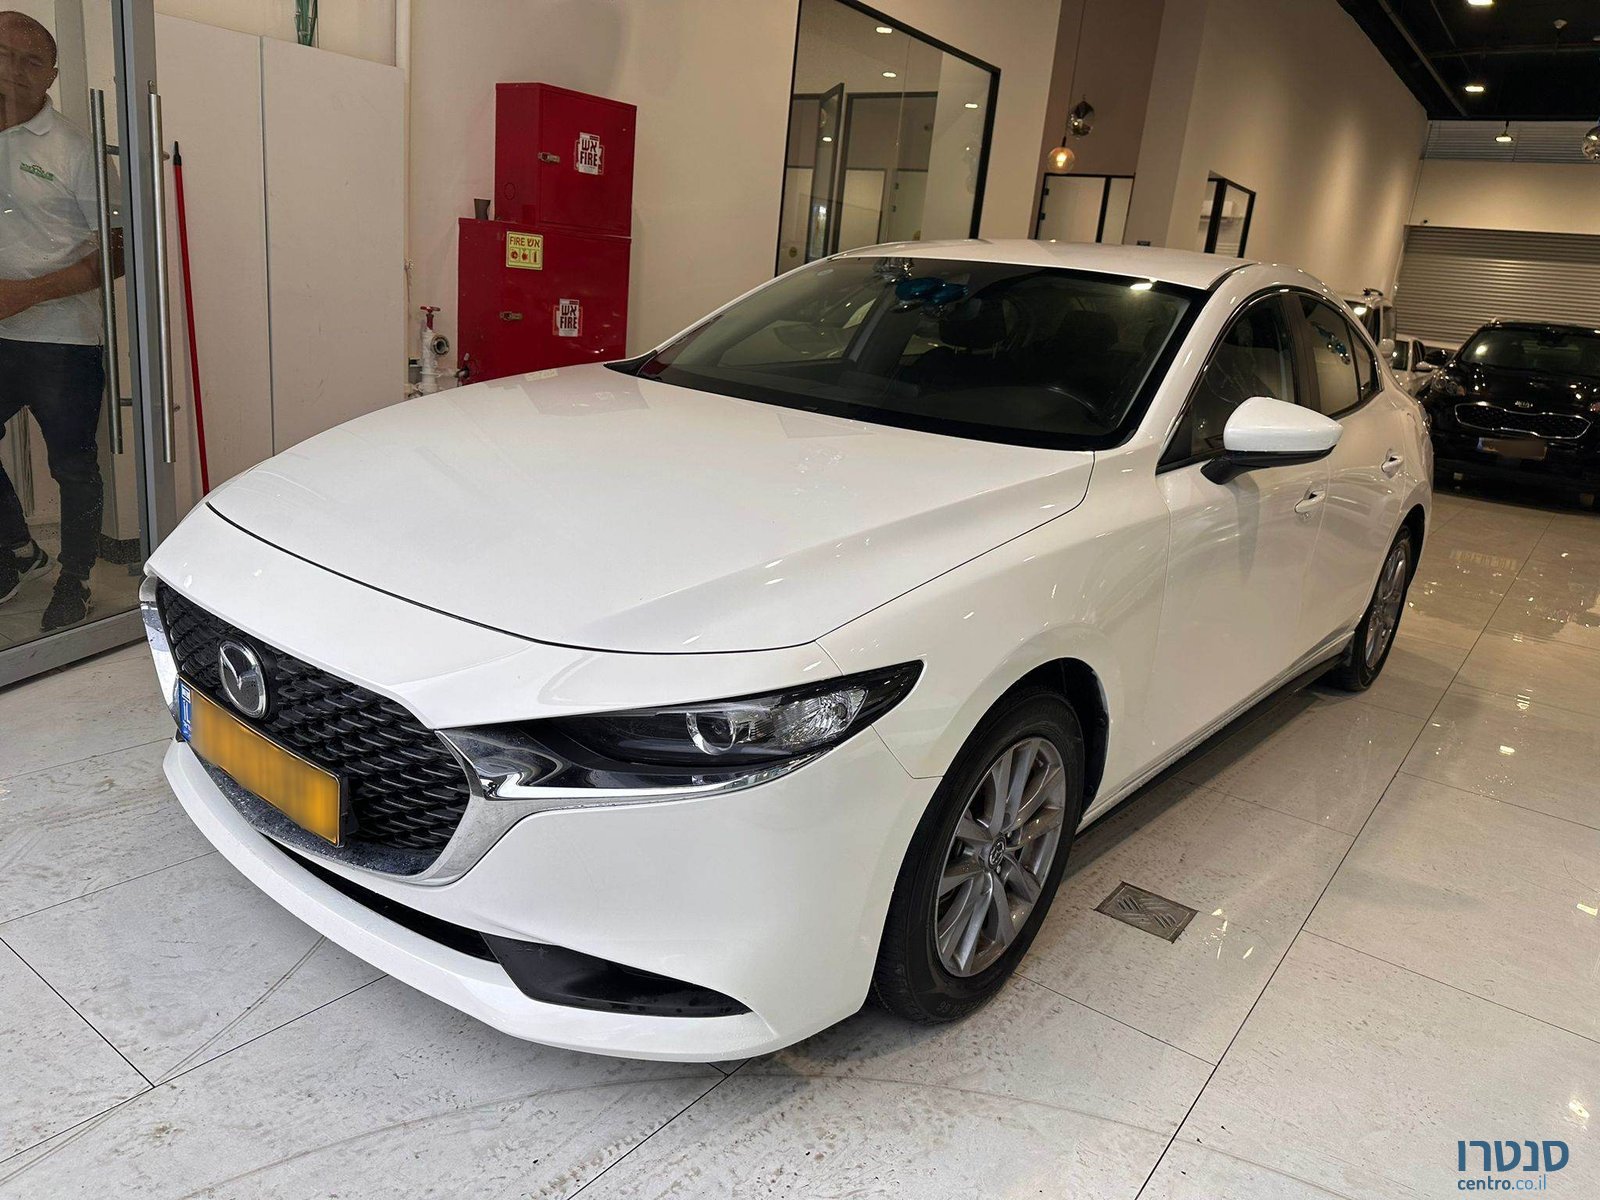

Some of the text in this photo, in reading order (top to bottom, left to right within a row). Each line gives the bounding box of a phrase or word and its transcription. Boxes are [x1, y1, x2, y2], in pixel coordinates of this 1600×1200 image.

[582, 139, 598, 153] אש
[580, 151, 598, 167] FIRE
[509, 236, 540, 248] FIRE אש
[561, 305, 577, 317] אש
[560, 316, 577, 329] FIRE
